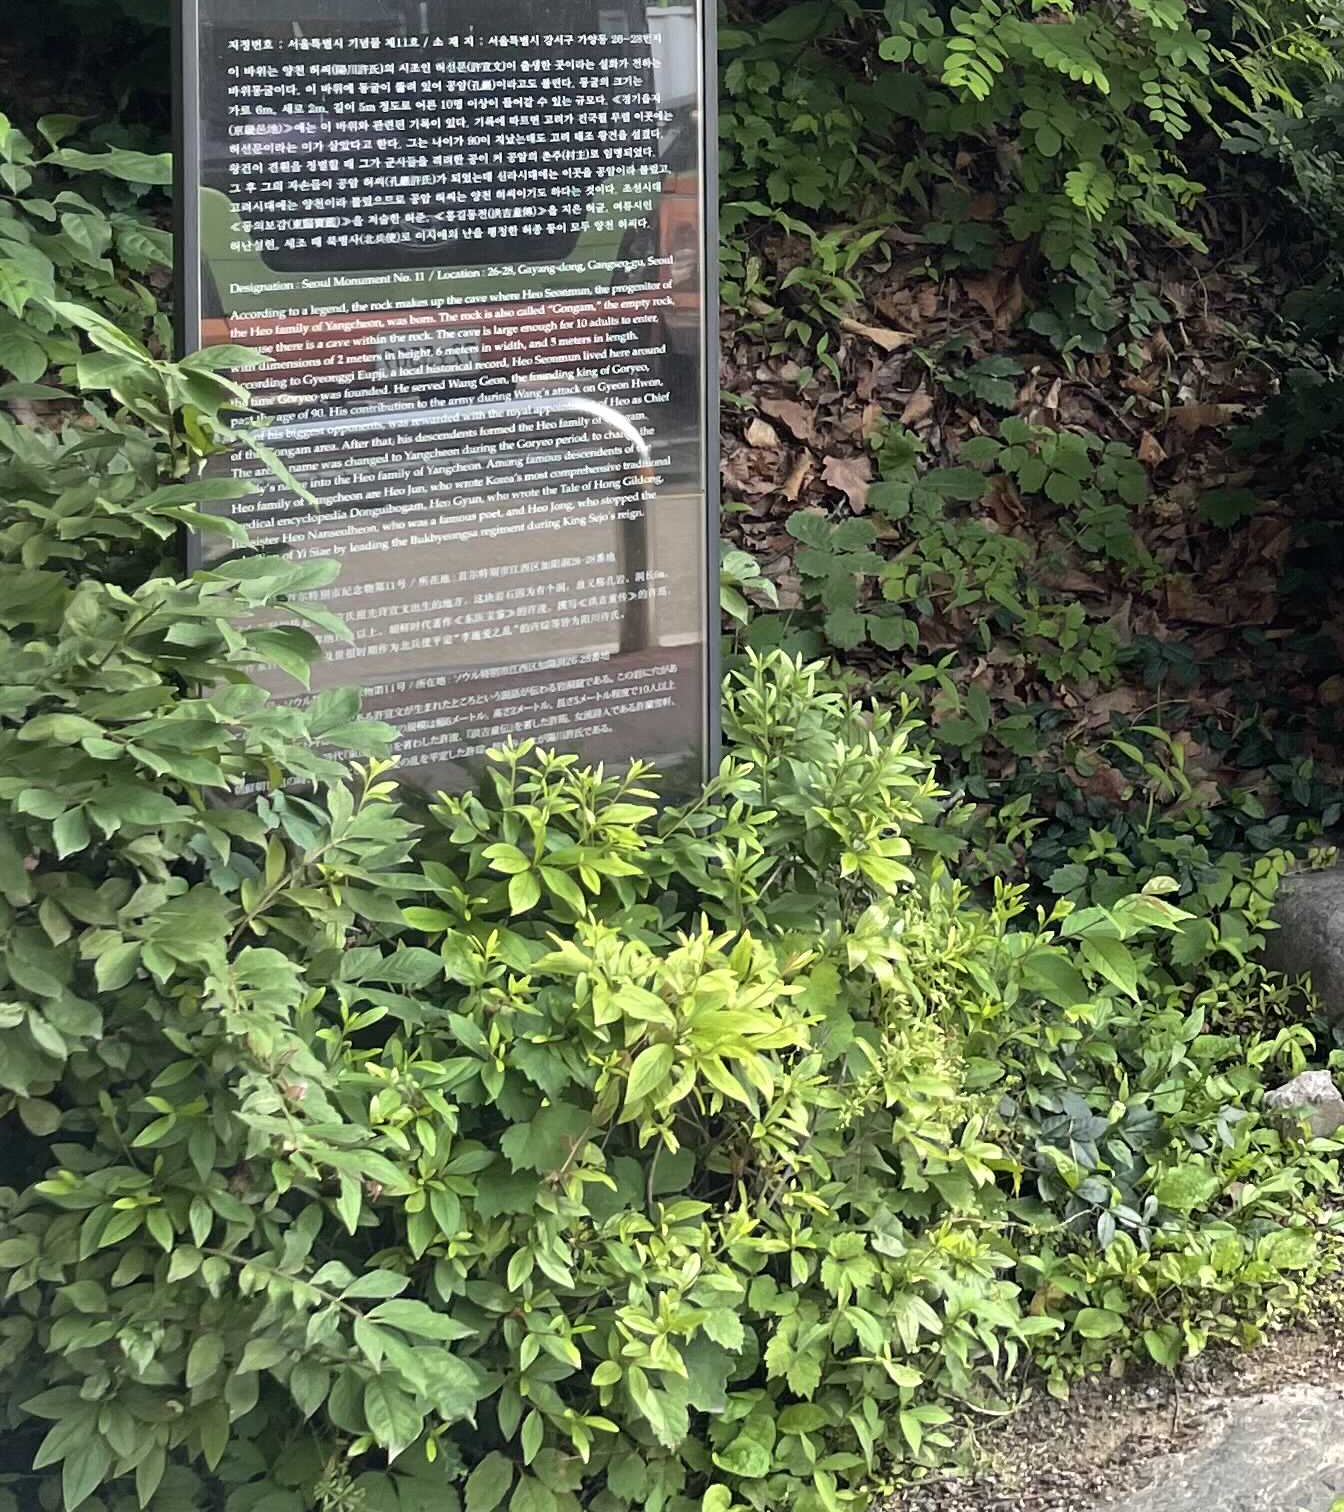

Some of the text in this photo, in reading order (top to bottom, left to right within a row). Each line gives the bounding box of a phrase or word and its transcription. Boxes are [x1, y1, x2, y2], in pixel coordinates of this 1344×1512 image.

[228, 33, 607, 51] 지정번호 서울특별시 기념물 제11호 서울특별시 강서구 가양동
[244, 56, 661, 77] 바위는 시조인 곳이라는 설화가 전하는
[228, 75, 642, 96] 바위동굴이다. 바위에 동굴이 있어 동굴의 크기는
[228, 94, 607, 116] 가로 세로 길이 정도로 어른 10명 이상이 들어갈 있는 규모다.
[336, 113, 573, 131] 바위와 관련된 기록이 기록에 따르면 고려가
[327, 129, 627, 151] 살았다고 한다. 그는 나이가 고려 왕건을
[229, 150, 537, 174] 왕건이 그가 군사들을 공암의
[288, 166, 592, 191] 자손들이 이곳을
[230, 199, 297, 212] 고려시대에는
[409, 192, 431, 204] 공암
[622, 181, 660, 193] 조선시대
[230, 255, 672, 294] Designation Seoul Monument Location 26-28, Seoul
[230, 282, 660, 320] According legend, the rock makes up the cave where the progenitor
[230, 327, 247, 337] the
[250, 326, 272, 336] Heo
[275, 323, 308, 335] family
[409, 314, 436, 324] born.
[438, 312, 457, 322] The
[460, 309, 482, 320] rock
[494, 307, 514, 318] also
[516, 304, 545, 316] called
[604, 299, 618, 309] the
[620, 299, 650, 310] empty
[275, 342, 303, 352] there
[325, 339, 350, 348] cave
[352, 334, 386, 345] within
[389, 333, 405, 343] the
[408, 330, 433, 341] rock.
[436, 329, 454, 338] The
[457, 329, 480, 337] cave
[493, 325, 518, 336] large
[520, 320, 557, 333] enough
[559, 319, 573, 329] for
[588, 316, 619, 326] adults
[302, 344, 665, 386] Gyeonggi local historical lived around
[345, 336, 591, 363] meters meters width, and meters
[276, 367, 597, 405] Goryeo founded. He served Wang founding king
[349, 381, 628, 412] contribution the army during attack Gyeon
[643, 391, 669, 403] Chief
[341, 416, 589, 449] After formed the family
[287, 440, 514, 472] name changed Yangcheon during the
[378, 446, 622, 480] family famous descendents
[256, 463, 621, 511] family wrote comprehensive
[277, 479, 620, 524] encyclopedia wrote Hong
[439, 491, 638, 524] famous stopped
[350, 519, 560, 552] leading regiment during
